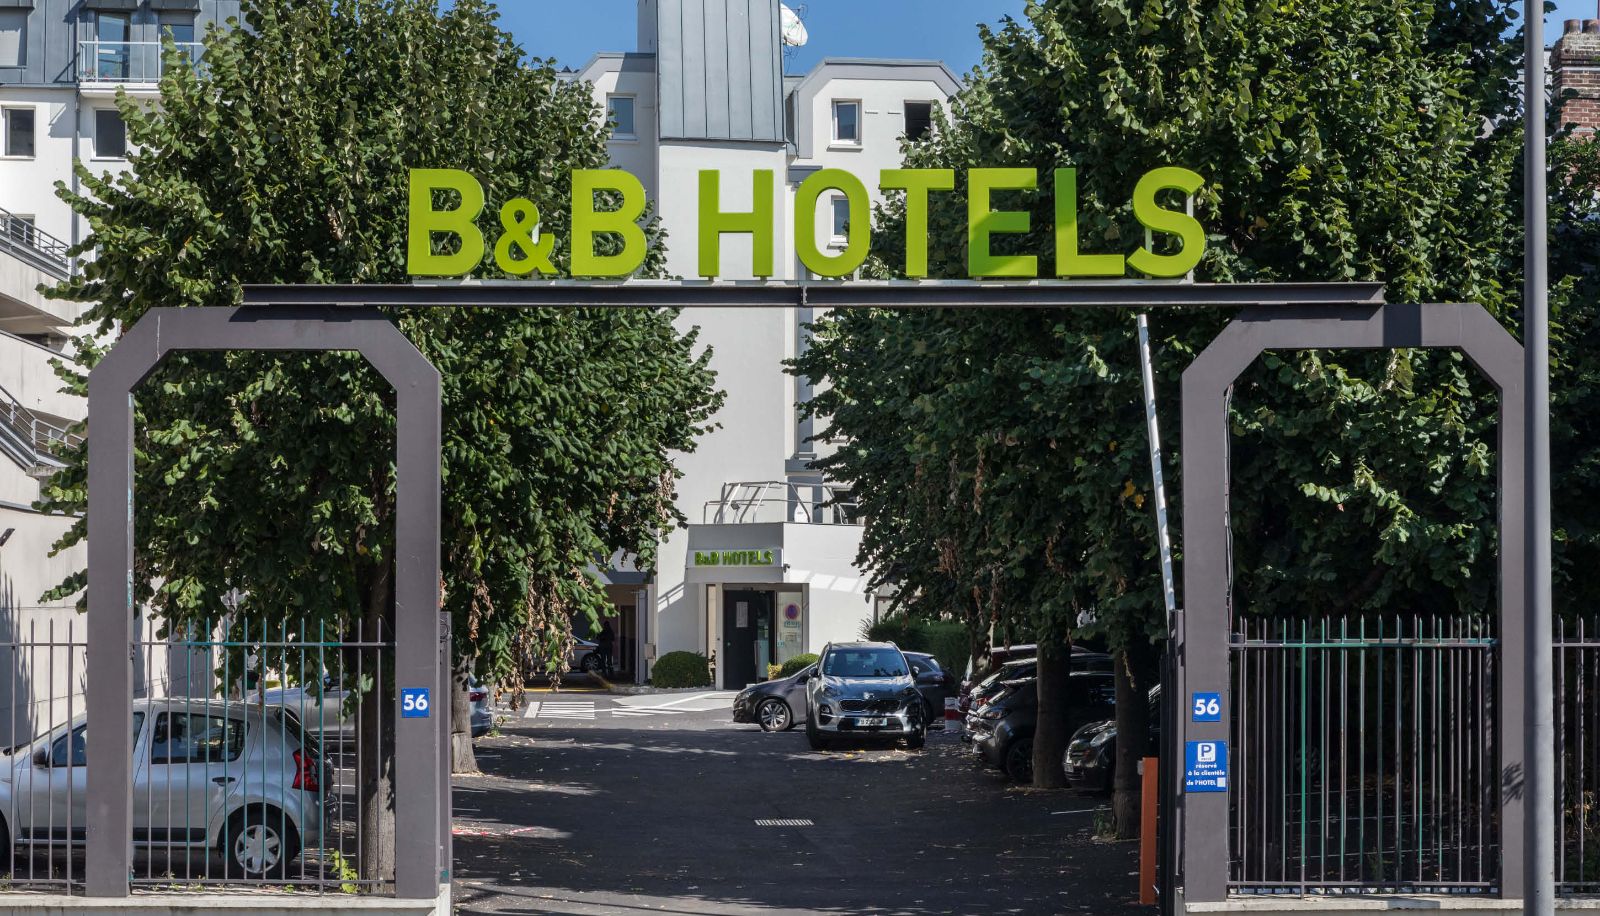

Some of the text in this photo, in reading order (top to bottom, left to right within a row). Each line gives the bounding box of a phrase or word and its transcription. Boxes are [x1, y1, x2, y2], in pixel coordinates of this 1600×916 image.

[407, 168, 1208, 278] B&B HOTELS
[722, 550, 773, 565] HOTELS
[404, 694, 428, 711] 56
[1194, 698, 1219, 715] 56
[1201, 744, 1212, 757] P
